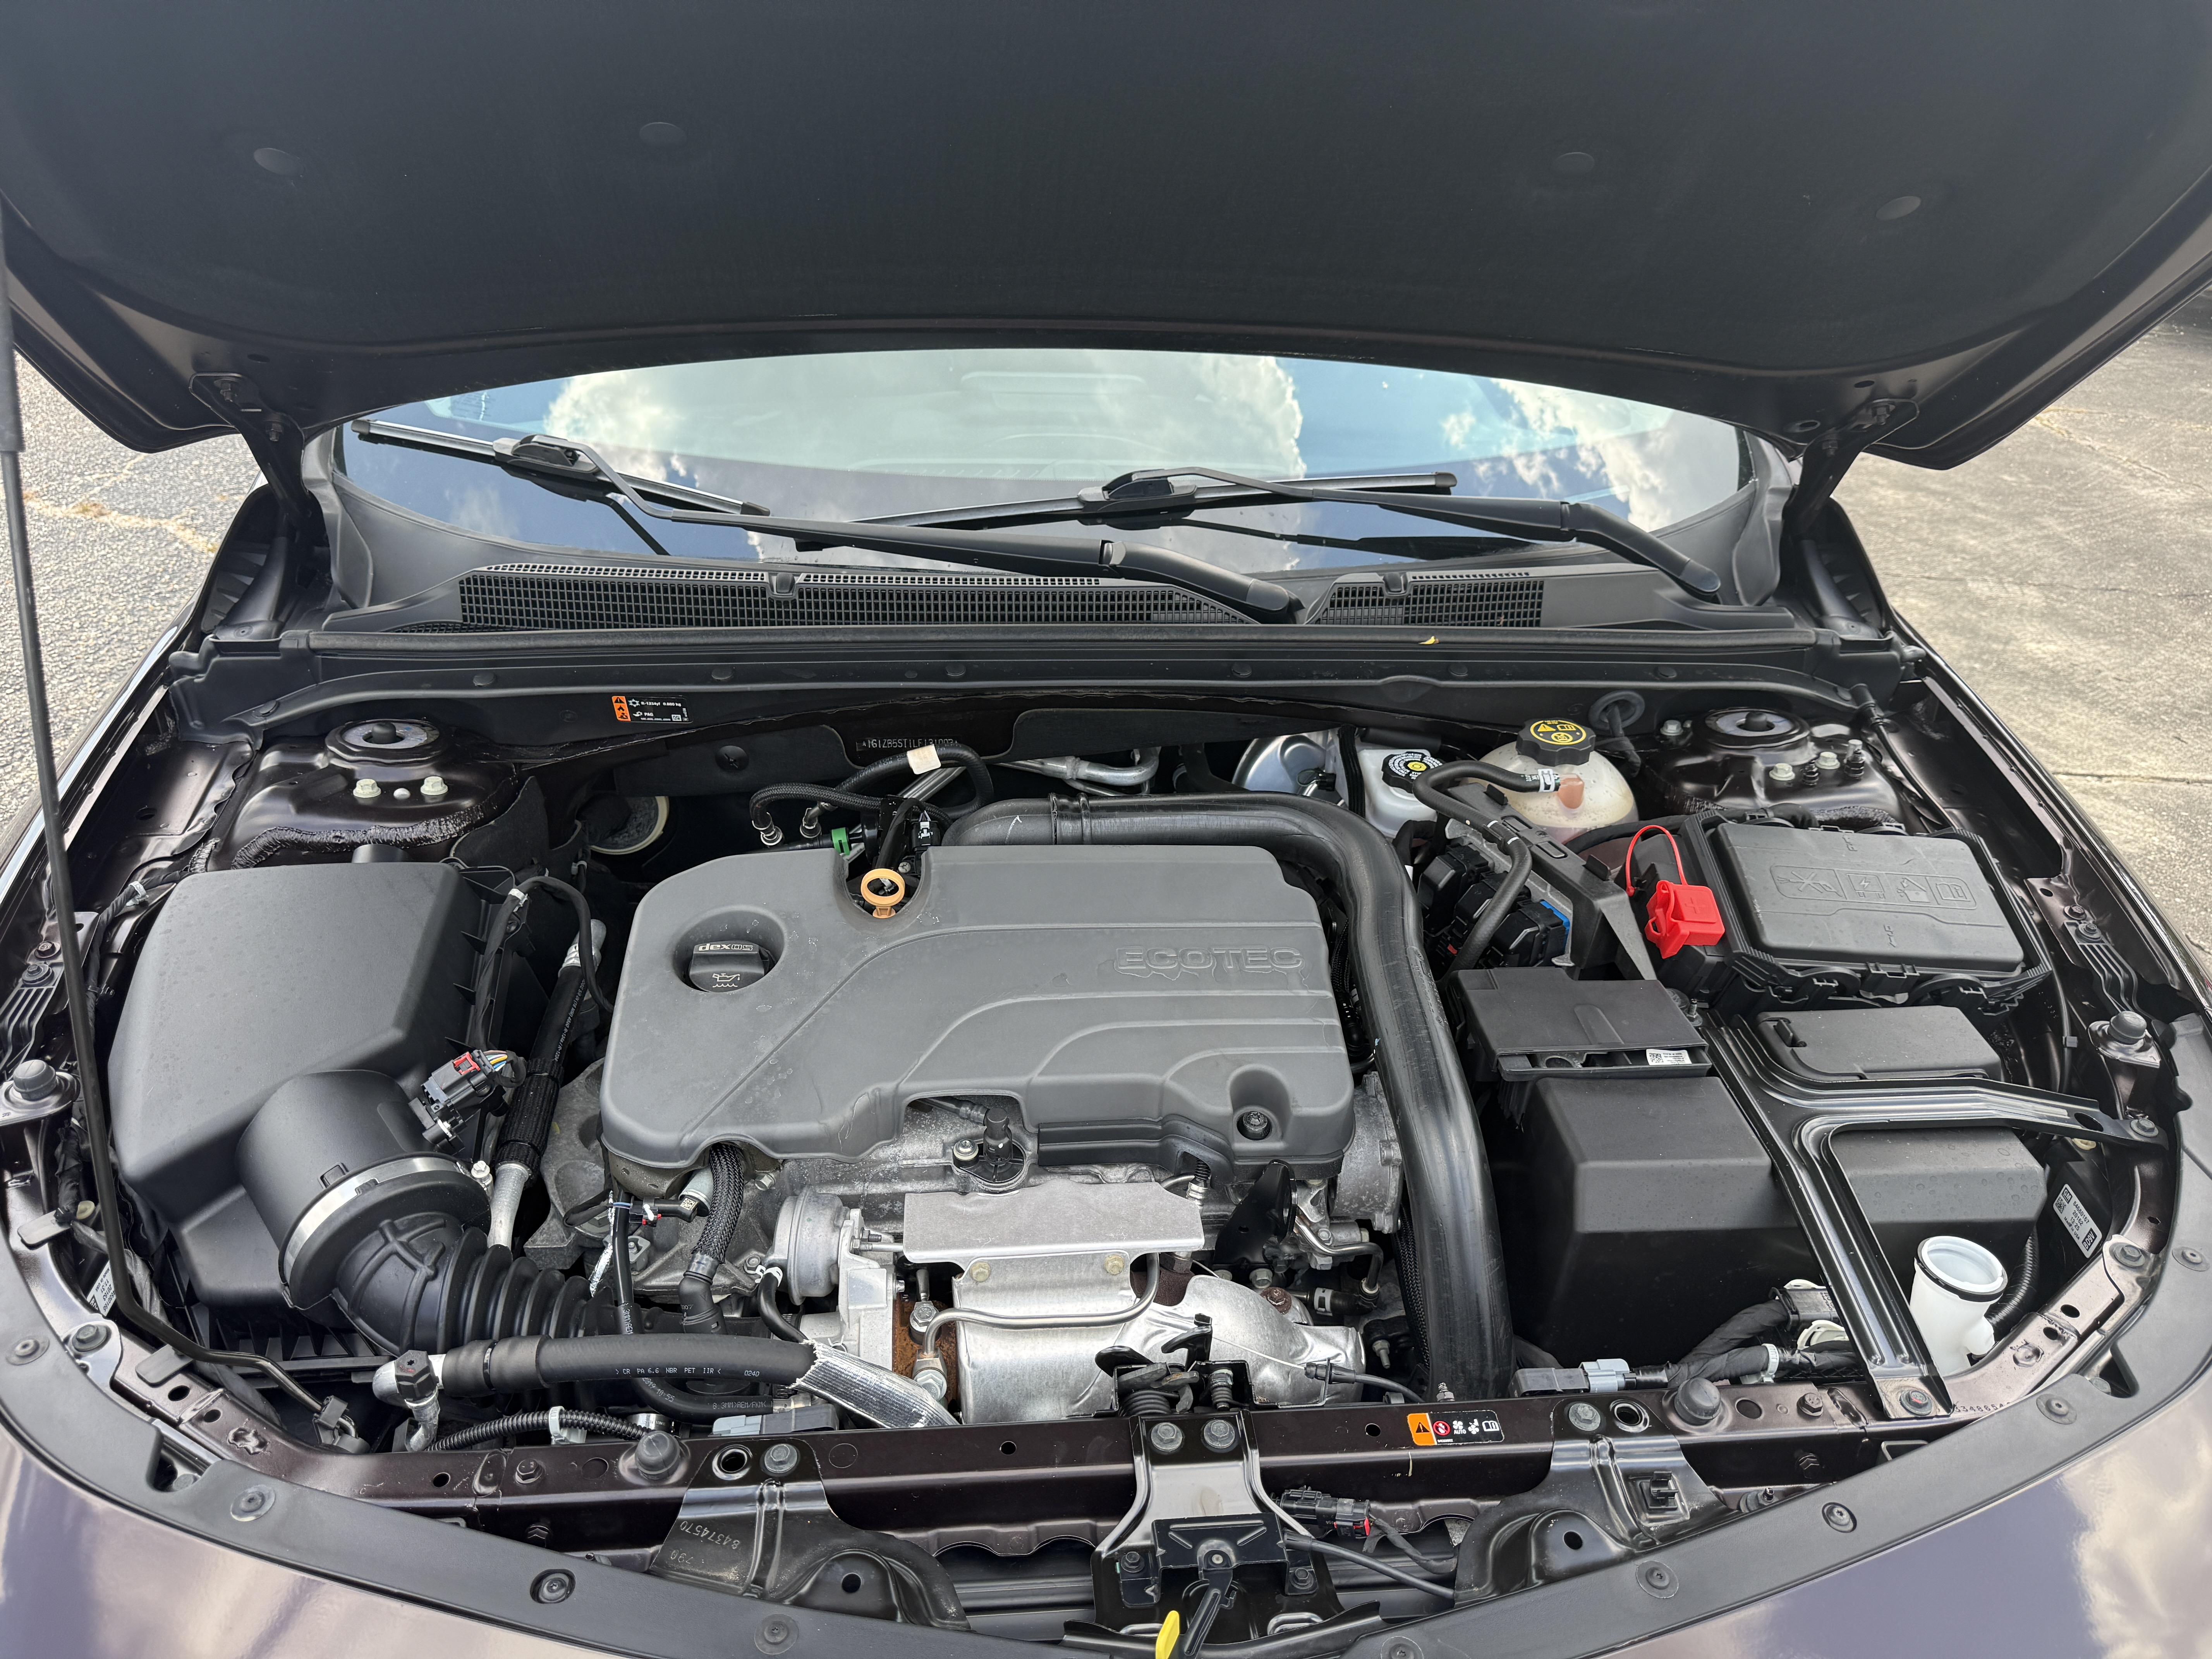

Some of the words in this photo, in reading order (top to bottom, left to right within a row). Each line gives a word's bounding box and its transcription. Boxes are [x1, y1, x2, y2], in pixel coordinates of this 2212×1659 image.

[1116, 947, 1302, 969] ECOTEC
[2063, 1188, 2072, 1202] GM
[2072, 1210, 2083, 1226] 20162
[2073, 1200, 2089, 1224] 84680167
